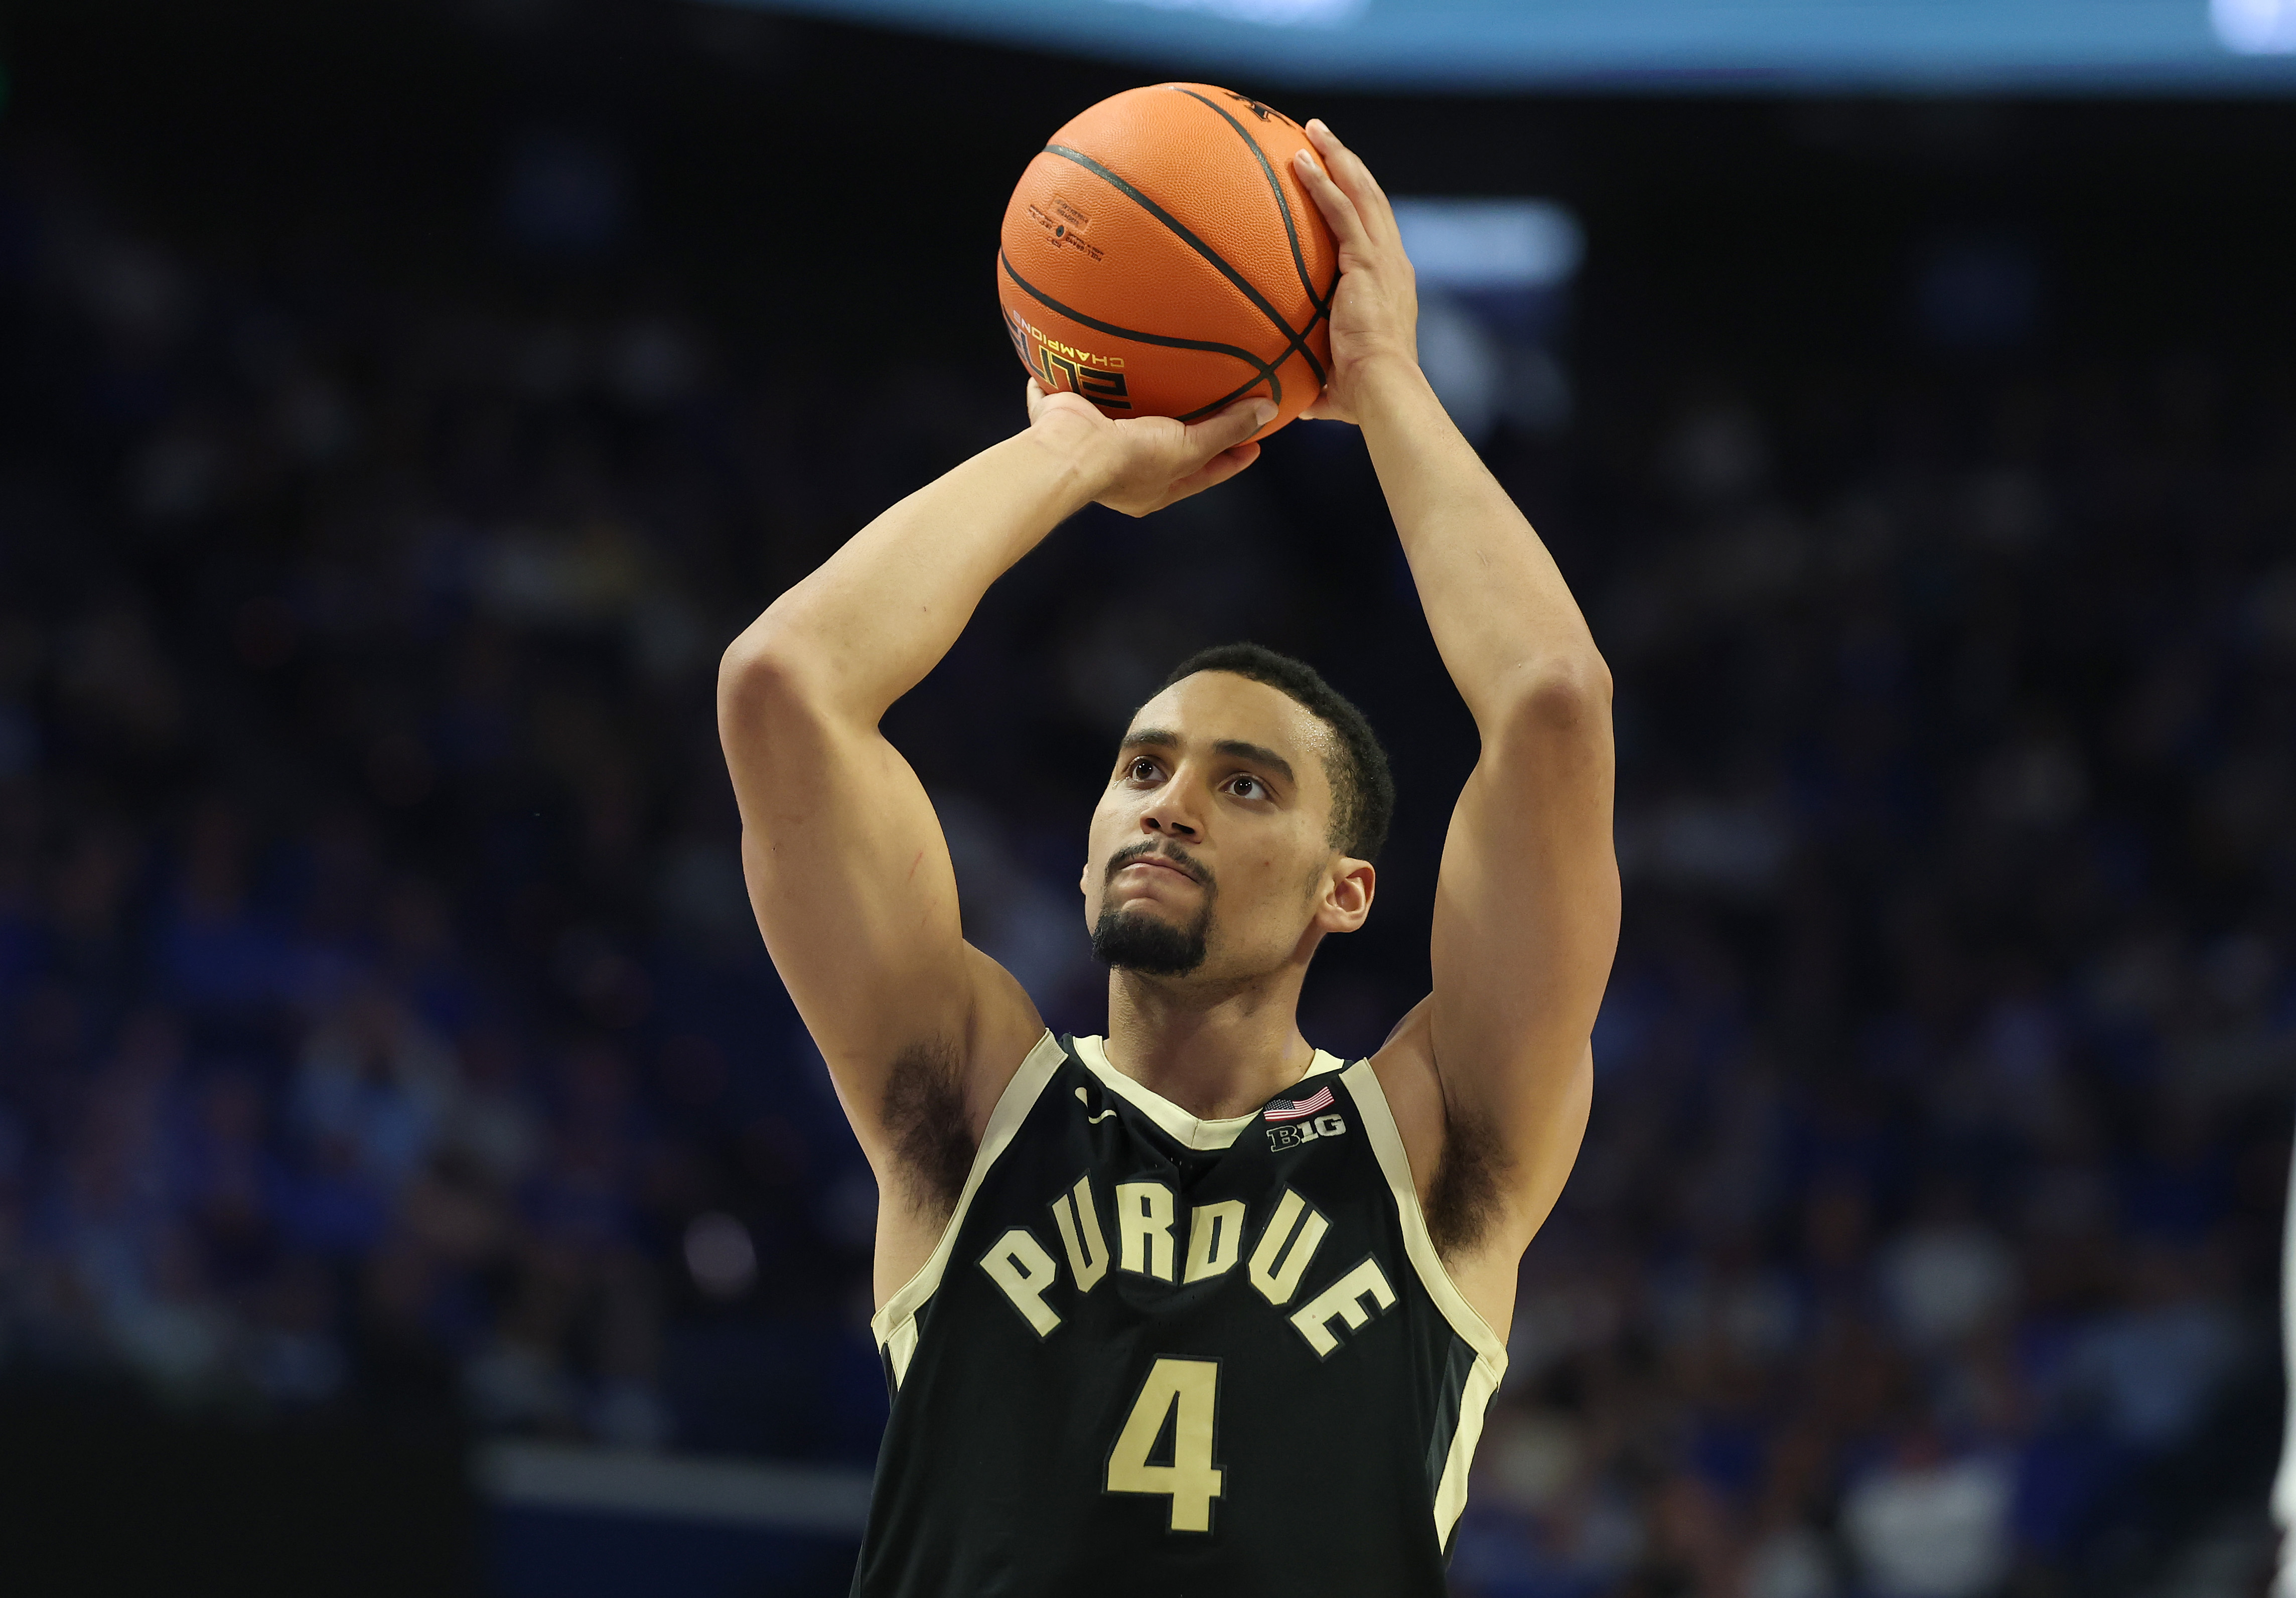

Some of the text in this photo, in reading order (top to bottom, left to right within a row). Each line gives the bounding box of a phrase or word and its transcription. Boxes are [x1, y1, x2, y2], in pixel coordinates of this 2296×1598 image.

[1013, 310, 1123, 367] CHAMPIONS
[976, 1171, 1399, 1361] PURDUE
[1104, 1355, 1224, 1533] 4
